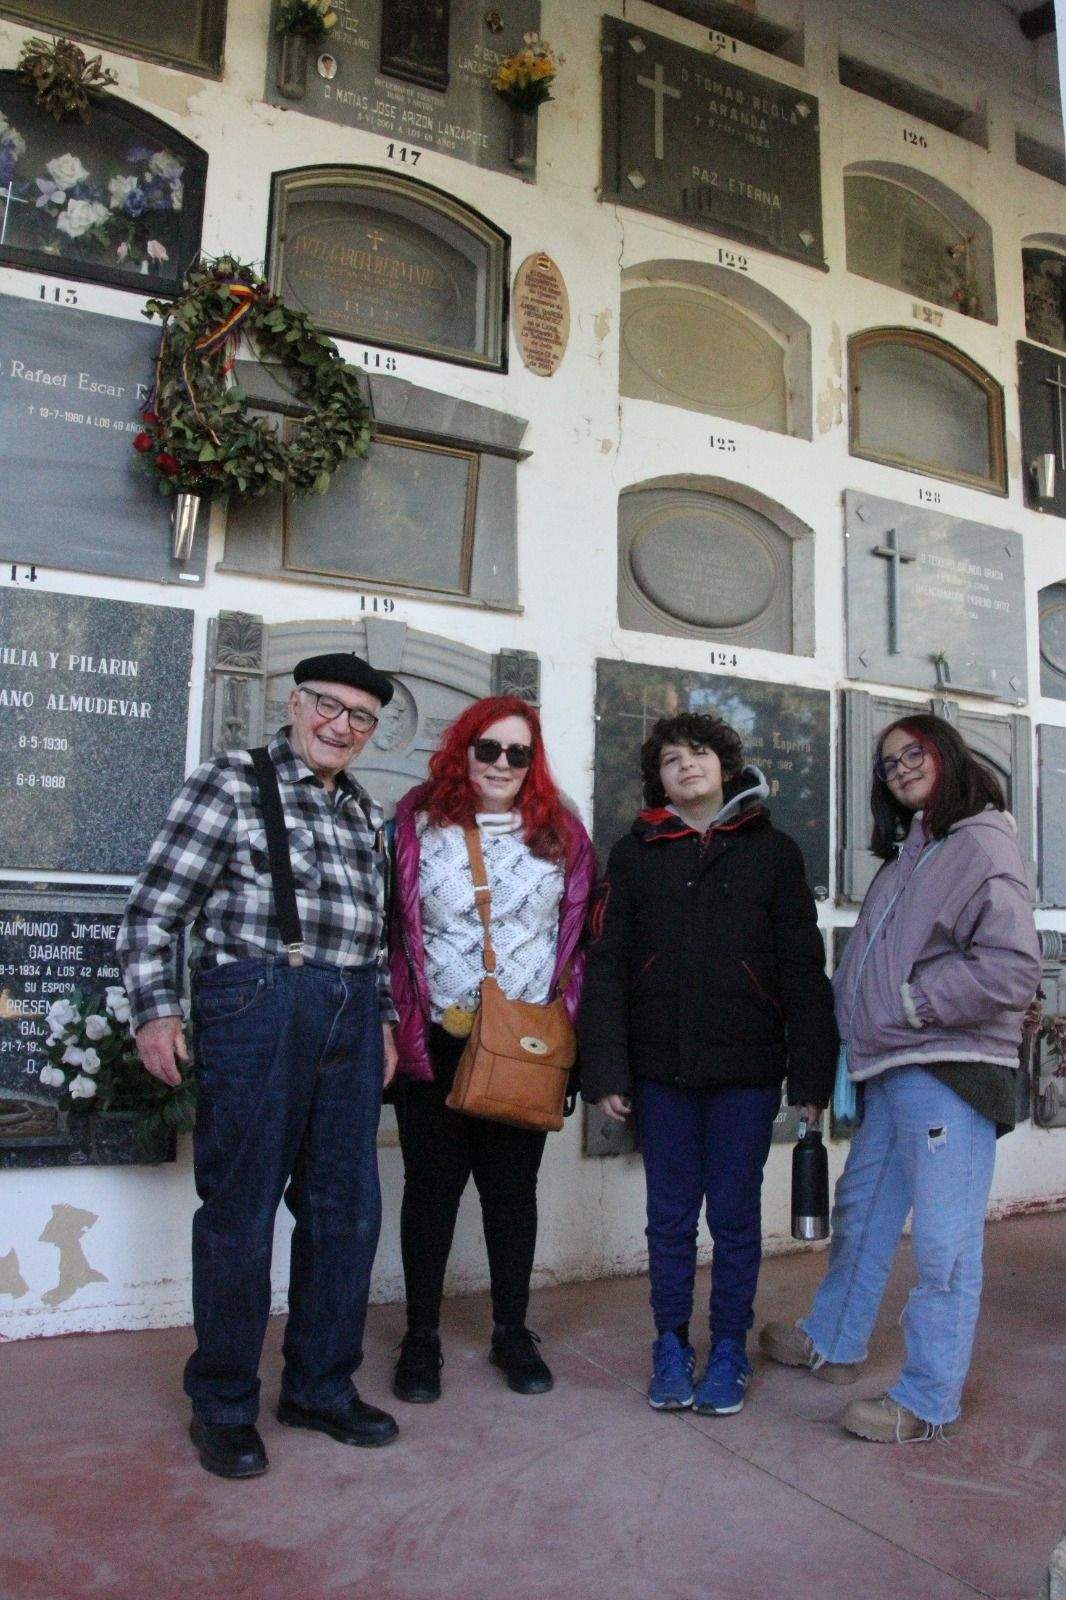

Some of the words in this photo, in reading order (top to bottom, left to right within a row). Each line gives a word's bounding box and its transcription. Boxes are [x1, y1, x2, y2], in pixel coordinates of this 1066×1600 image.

[709, 31, 736, 53] 121
[336, 88, 369, 111] MATIAS
[370, 101, 397, 120] JOSE
[401, 110, 434, 131] ARIZON
[438, 122, 489, 149] LANZAROTE
[386, 143, 422, 166] 117
[691, 164, 720, 187] PAZ
[728, 177, 782, 209] ETERNA
[718, 248, 749, 271] 122
[364, 351, 397, 372] 118
[11, 359, 67, 388] Rafael
[78, 373, 125, 398] Escar
[40, 407, 84, 424] 13-7-1980
[86, 415, 92, 425] A
[94, 417, 110, 429] LOS
[919, 488, 941, 504] 128
[360, 595, 395, 613] 119
[0, 647, 38, 668] ILIA
[50, 652, 59, 669] Y
[68, 654, 139, 677] PILARIN
[711, 651, 738, 667] 124
[46, 694, 152, 719] ALMUDEVAR
[19, 735, 68, 751] 8-5-1930
[16, 773, 66, 789] 6-8-1988
[71, 923, 120, 940] JIMENE
[29, 944, 84, 961] GABARRE
[46, 965, 52, 976] A
[57, 966, 75, 977] LOS
[80, 966, 92, 978] 42
[97, 964, 120, 978] AÑOS
[25, 982, 37, 993] SU
[42, 982, 76, 994] ESPOSA
